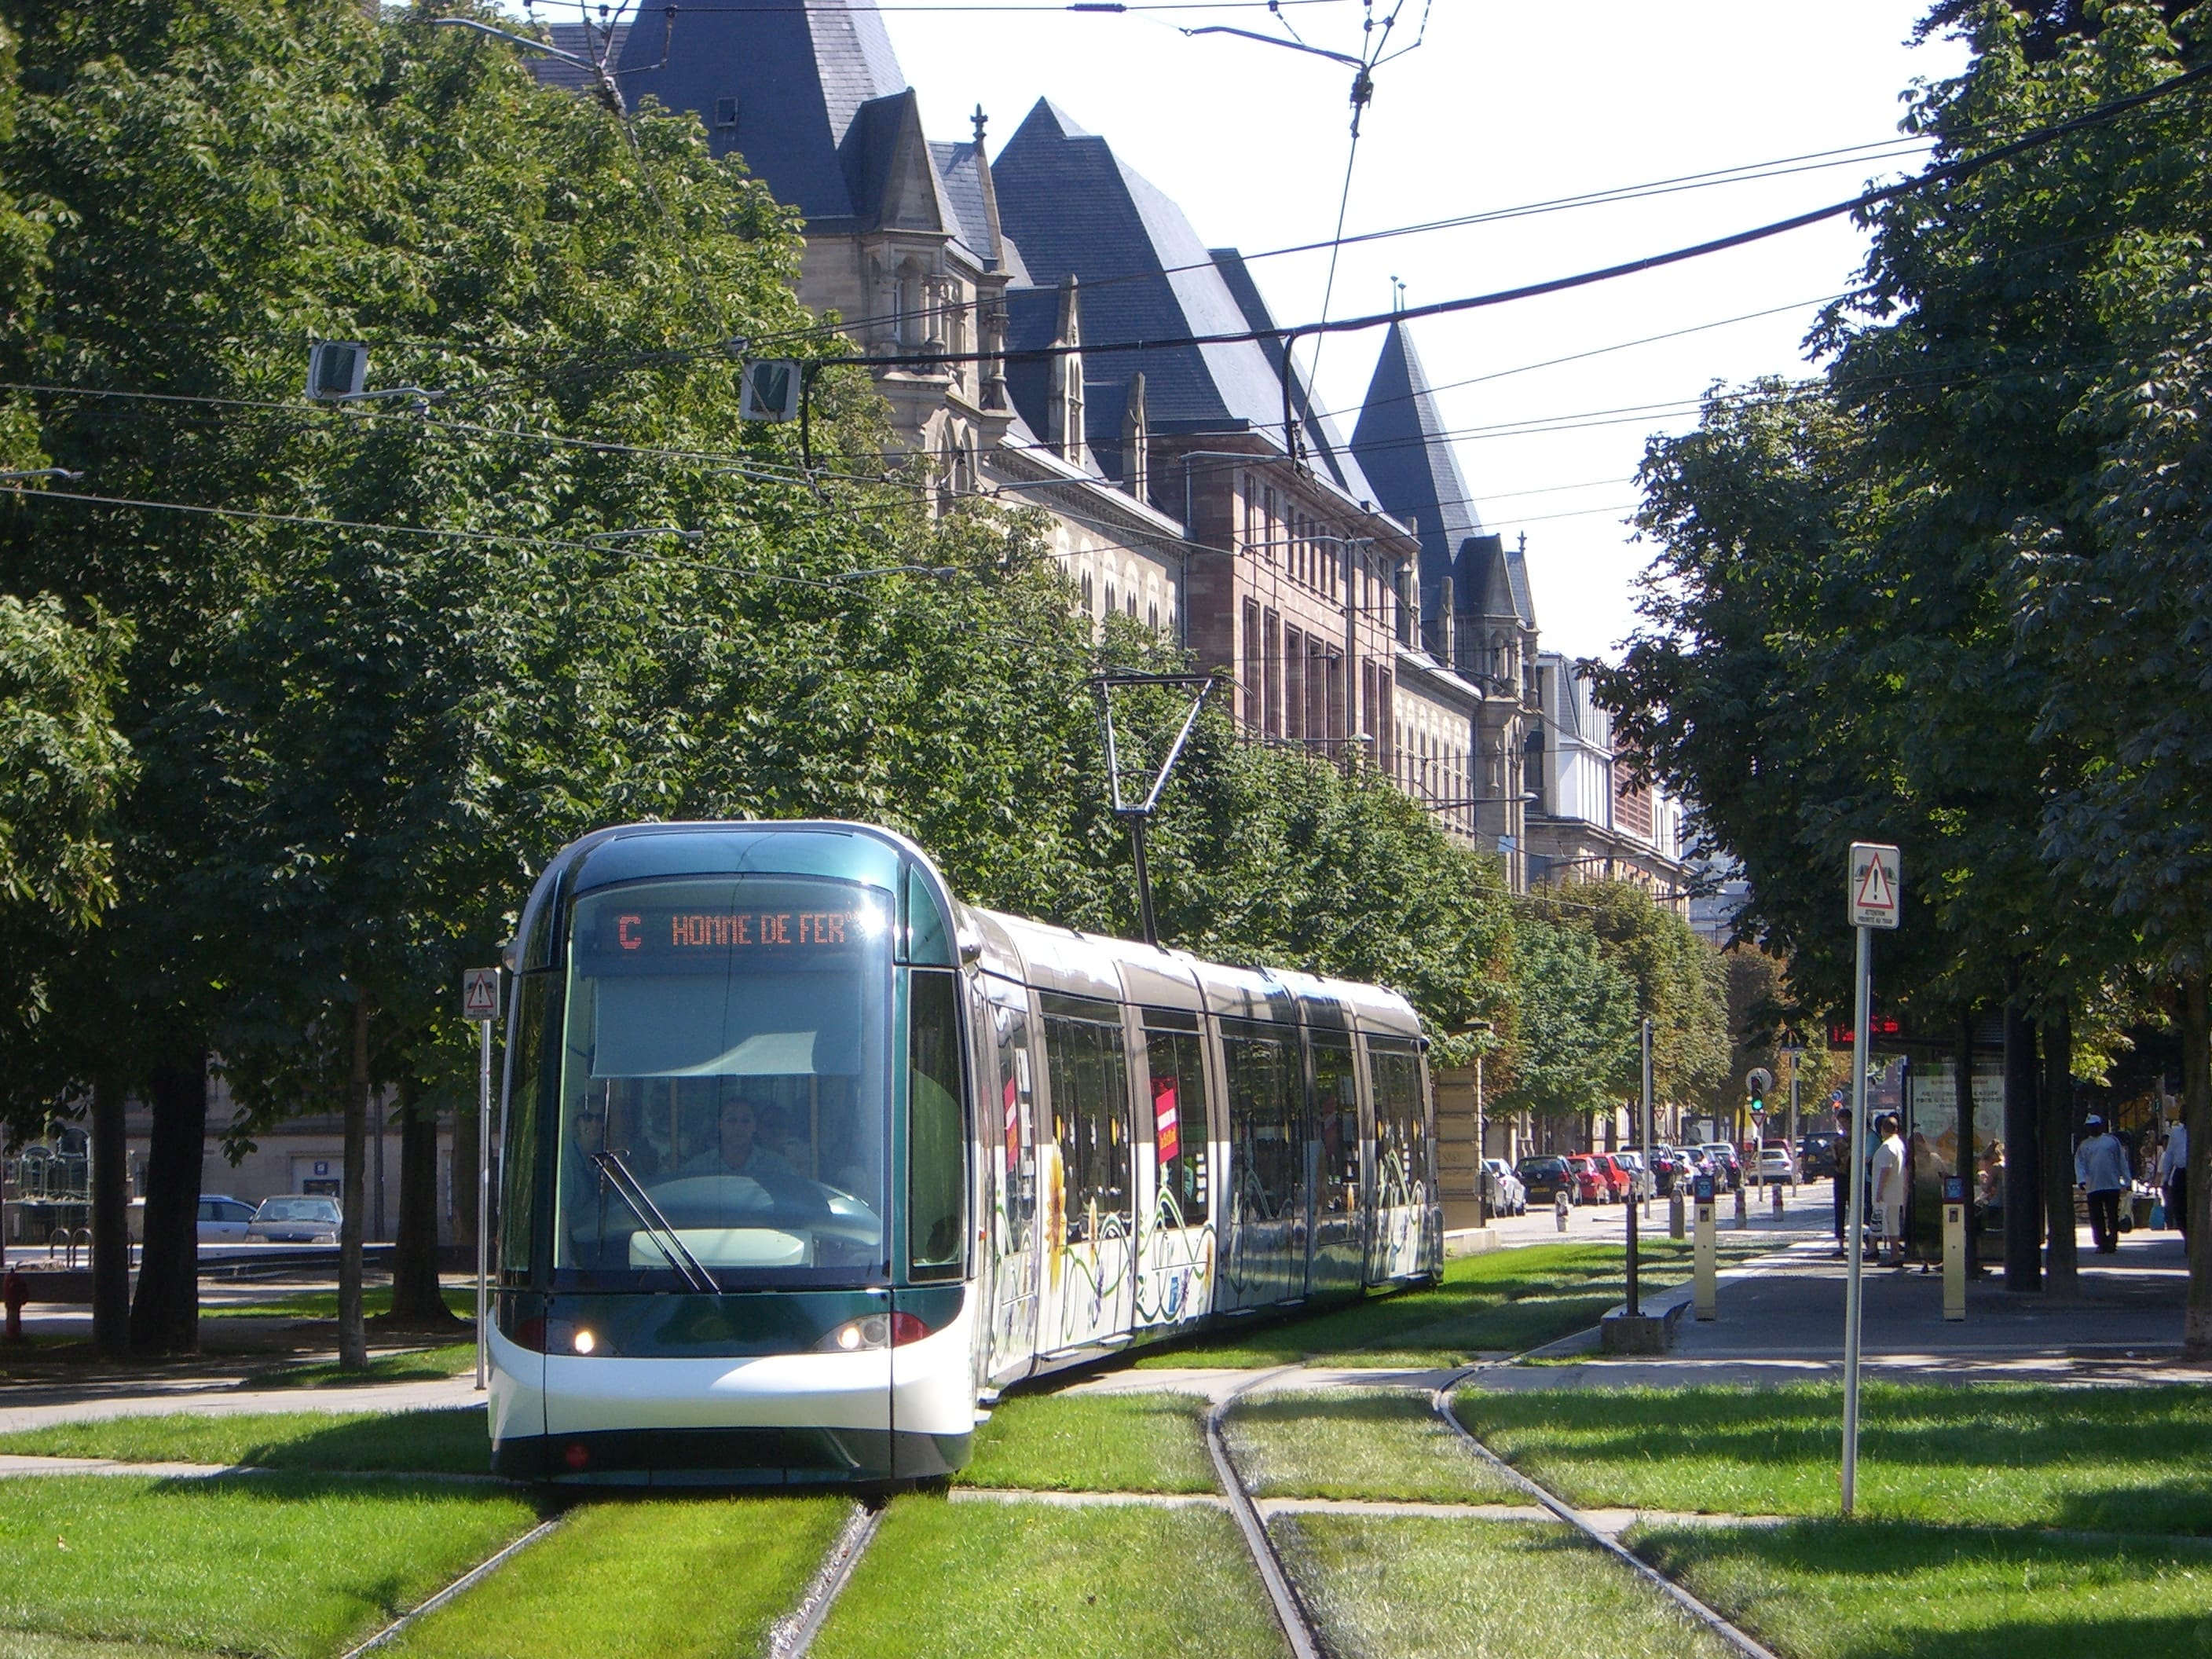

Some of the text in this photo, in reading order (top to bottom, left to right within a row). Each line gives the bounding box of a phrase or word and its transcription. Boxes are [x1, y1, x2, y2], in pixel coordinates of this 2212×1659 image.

[619, 913, 845, 949] C HOMME DE FER
